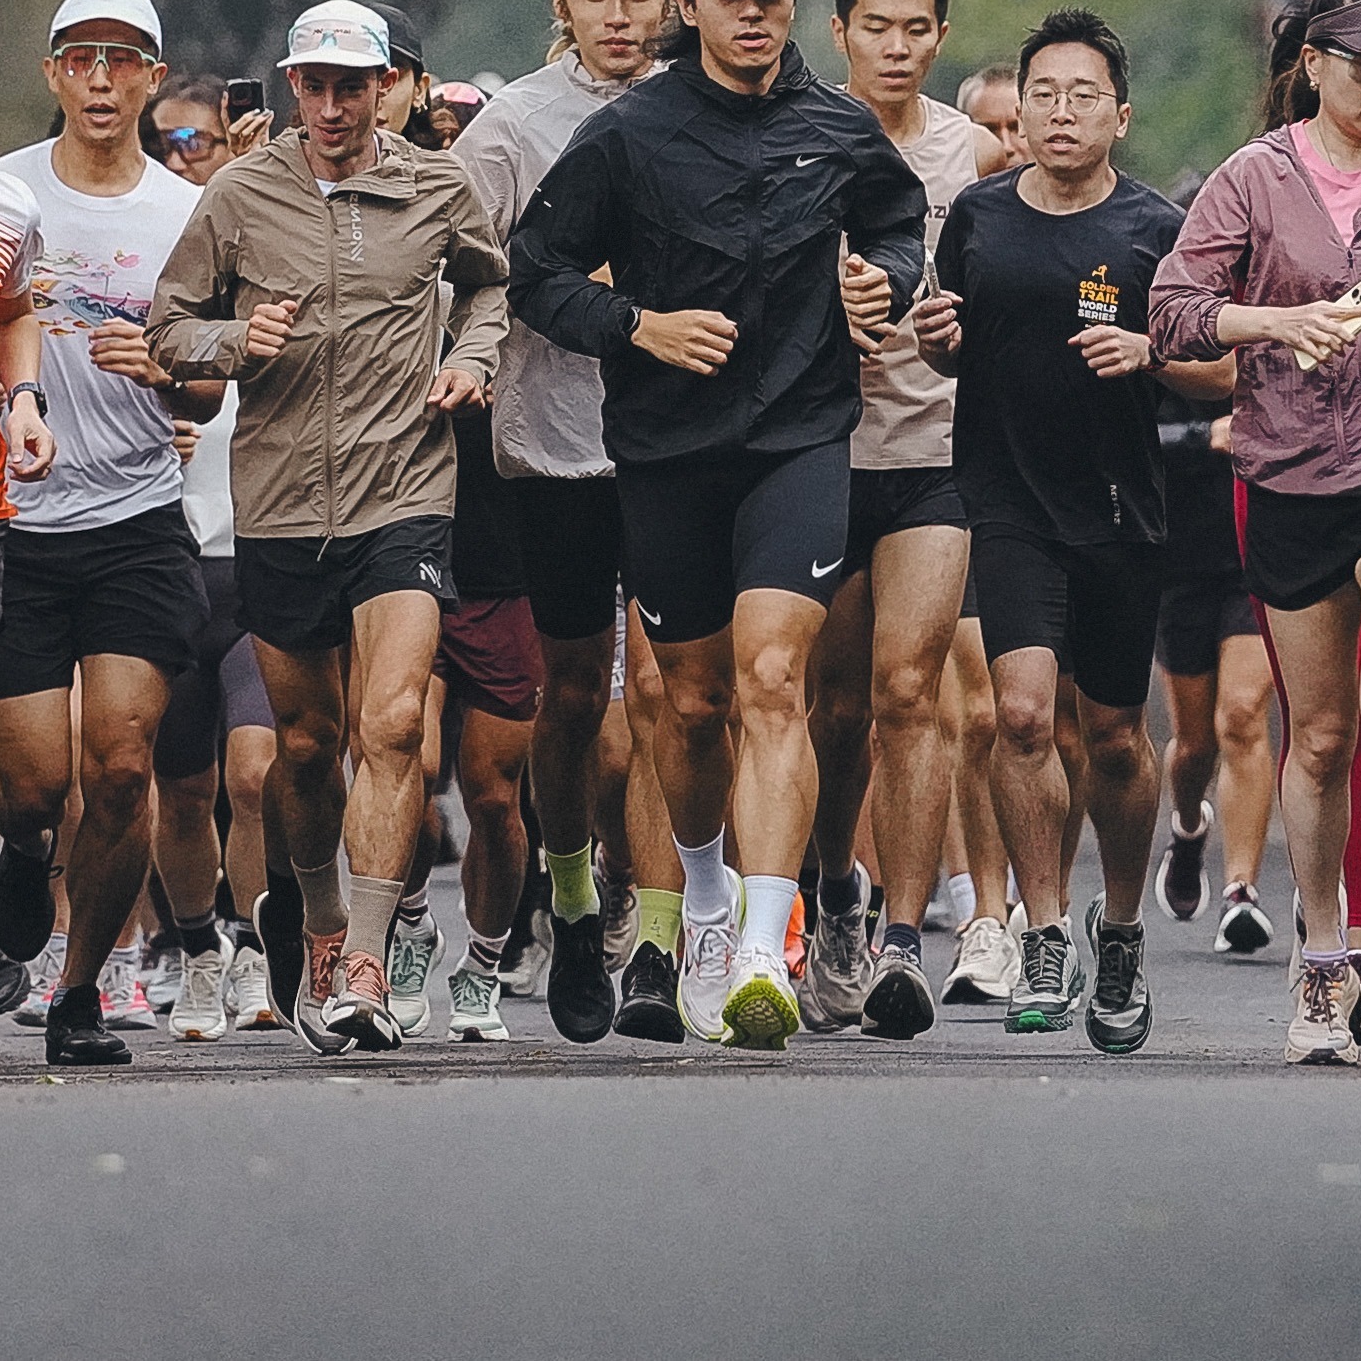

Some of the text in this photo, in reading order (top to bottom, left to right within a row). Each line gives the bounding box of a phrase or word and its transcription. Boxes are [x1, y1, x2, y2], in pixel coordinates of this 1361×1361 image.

[1079, 280, 1119, 294] GOLDEN
[1079, 288, 1118, 305] TRAIL
[1078, 299, 1118, 314] WORLD
[1078, 308, 1116, 322] SERIES
